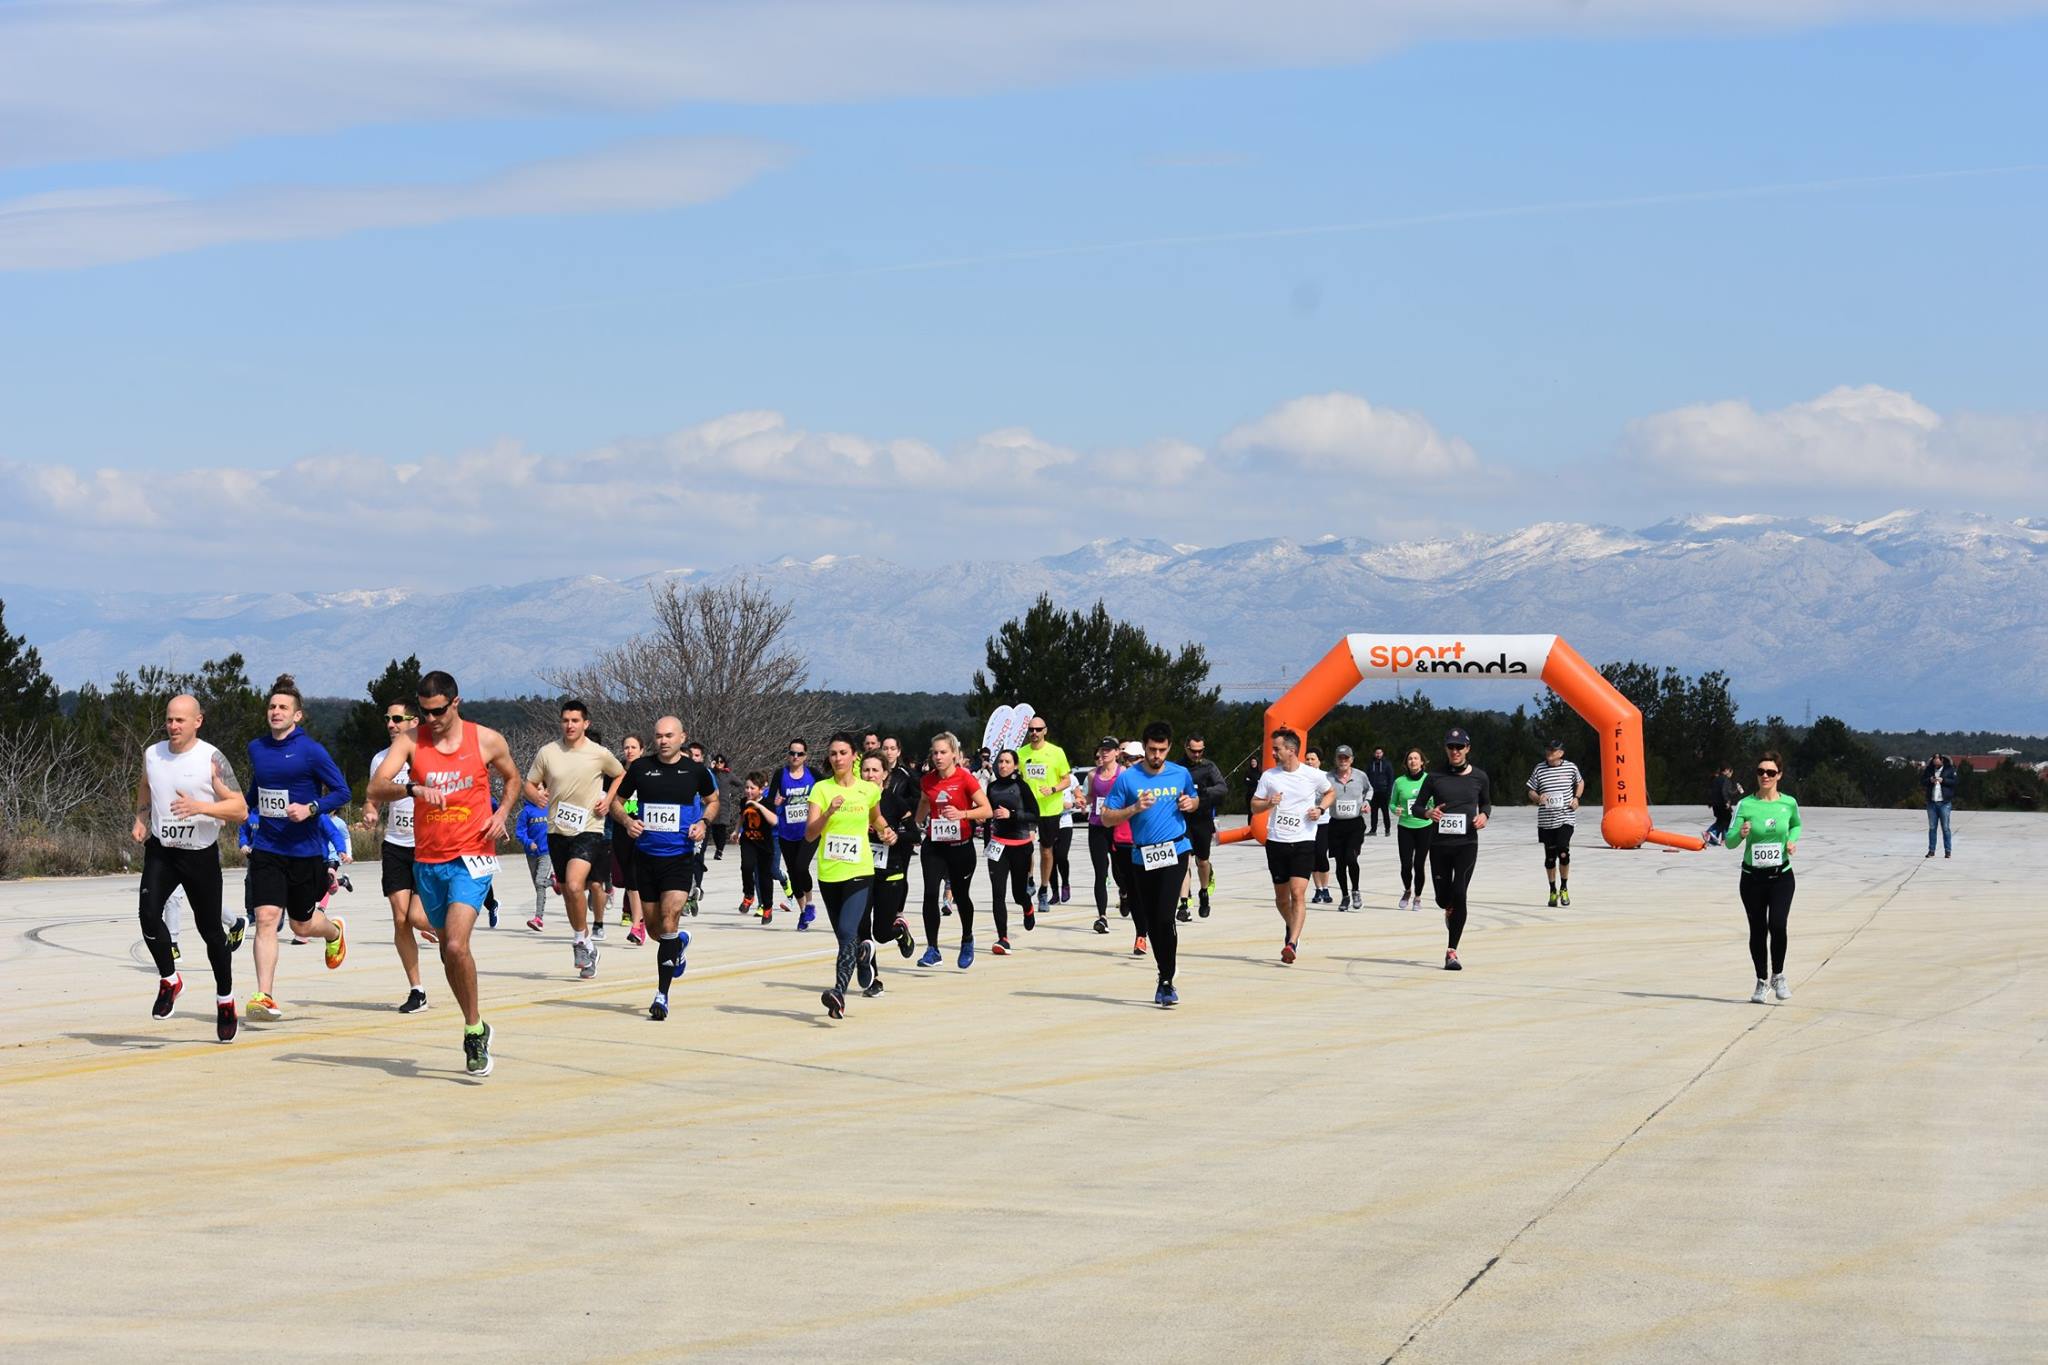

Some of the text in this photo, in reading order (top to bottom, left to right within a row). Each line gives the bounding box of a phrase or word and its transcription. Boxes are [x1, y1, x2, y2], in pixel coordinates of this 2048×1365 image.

[1370, 642, 1465, 673] sport
[1027, 768, 1045, 776] 1042
[1615, 728, 1627, 803] FINISH
[425, 770, 460, 787] RUN
[439, 776, 473, 796] ADAR
[260, 797, 285, 810] 1150
[1337, 804, 1355, 812] 1067
[557, 808, 584, 824] 2551
[646, 811, 676, 824] 1164
[787, 808, 809, 819] 5089
[395, 815, 415, 828] 255
[1276, 815, 1301, 828] 2562
[1440, 819, 1464, 829] 2561
[161, 825, 195, 839] 5077
[933, 824, 958, 835] 1149
[827, 841, 857, 855] 1174
[1754, 849, 1781, 860] 5082
[1145, 848, 1175, 864] 5094
